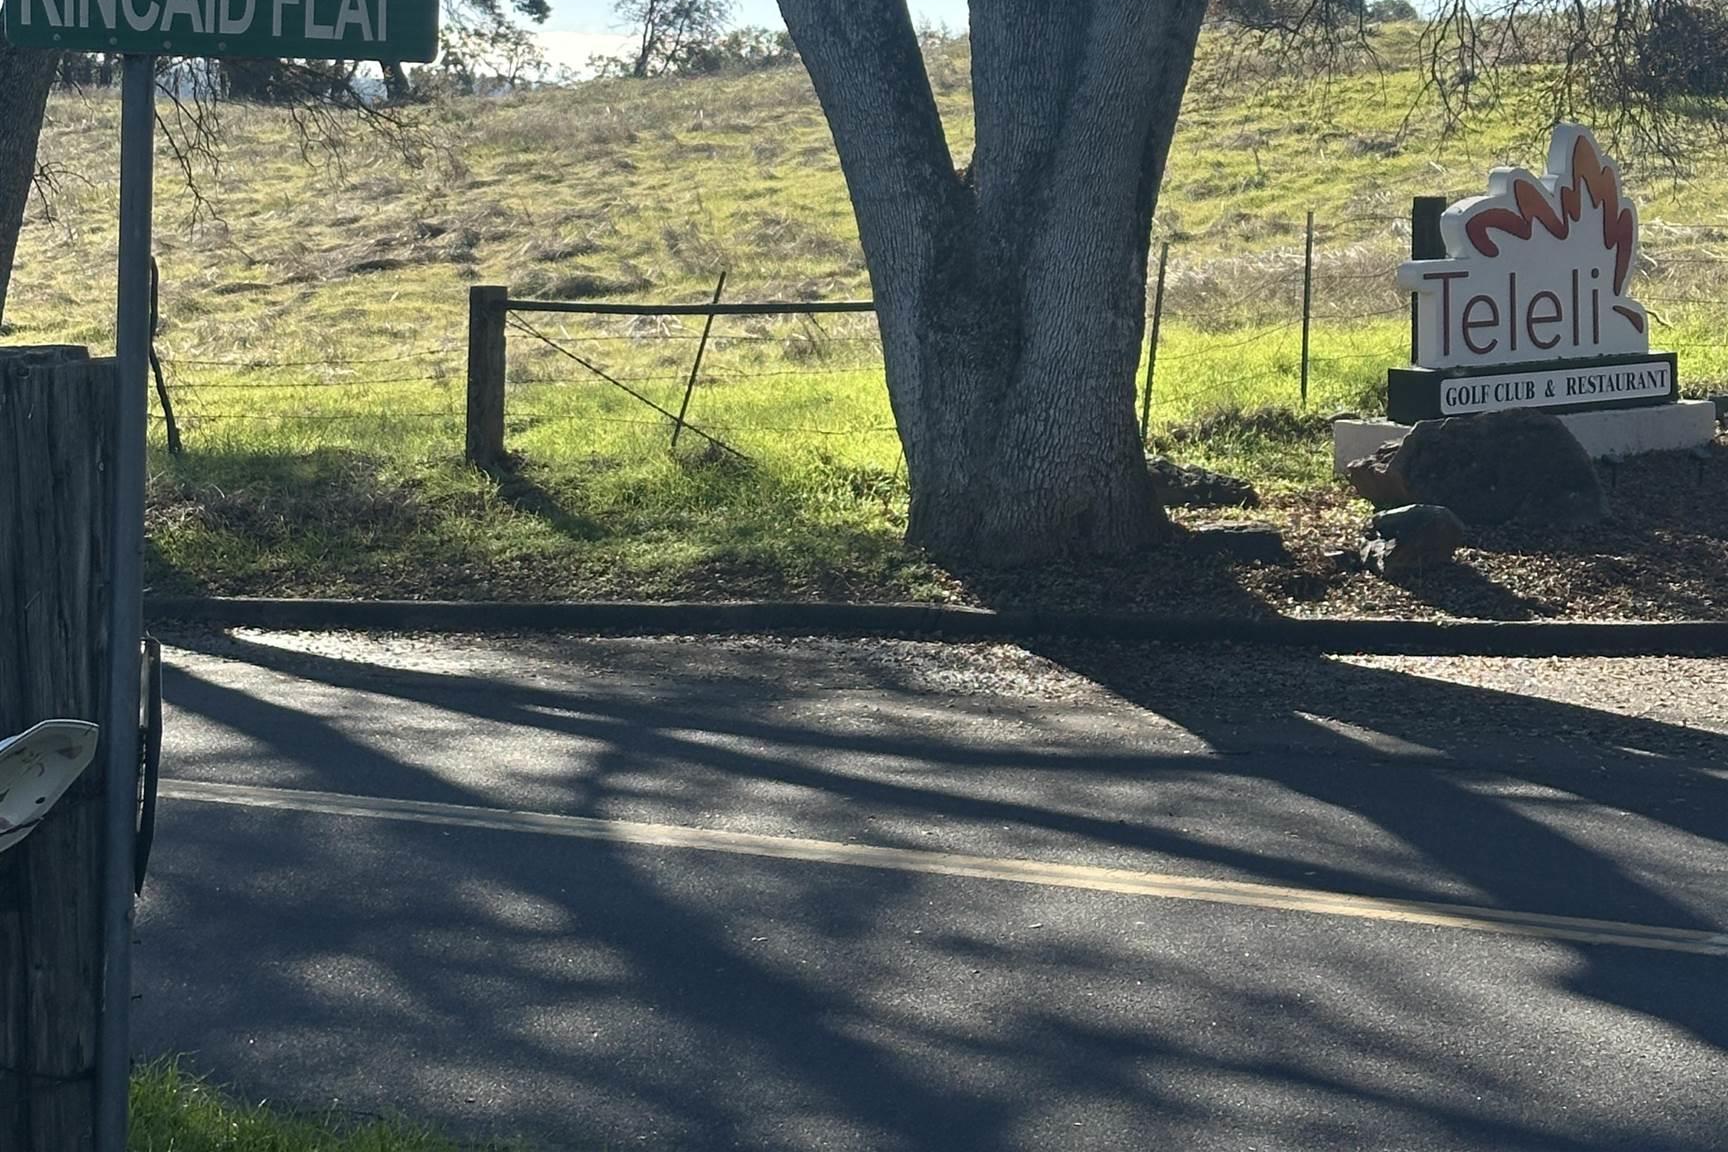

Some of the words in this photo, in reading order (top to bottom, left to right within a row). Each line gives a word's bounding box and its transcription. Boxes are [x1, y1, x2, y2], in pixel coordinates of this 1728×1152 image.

[1423, 268, 1601, 356] Teleli
[1445, 384, 1491, 408] GOLF
[1494, 380, 1536, 403] CLUB
[1544, 379, 1556, 397] &
[1566, 368, 1669, 396] RESTAURANT
